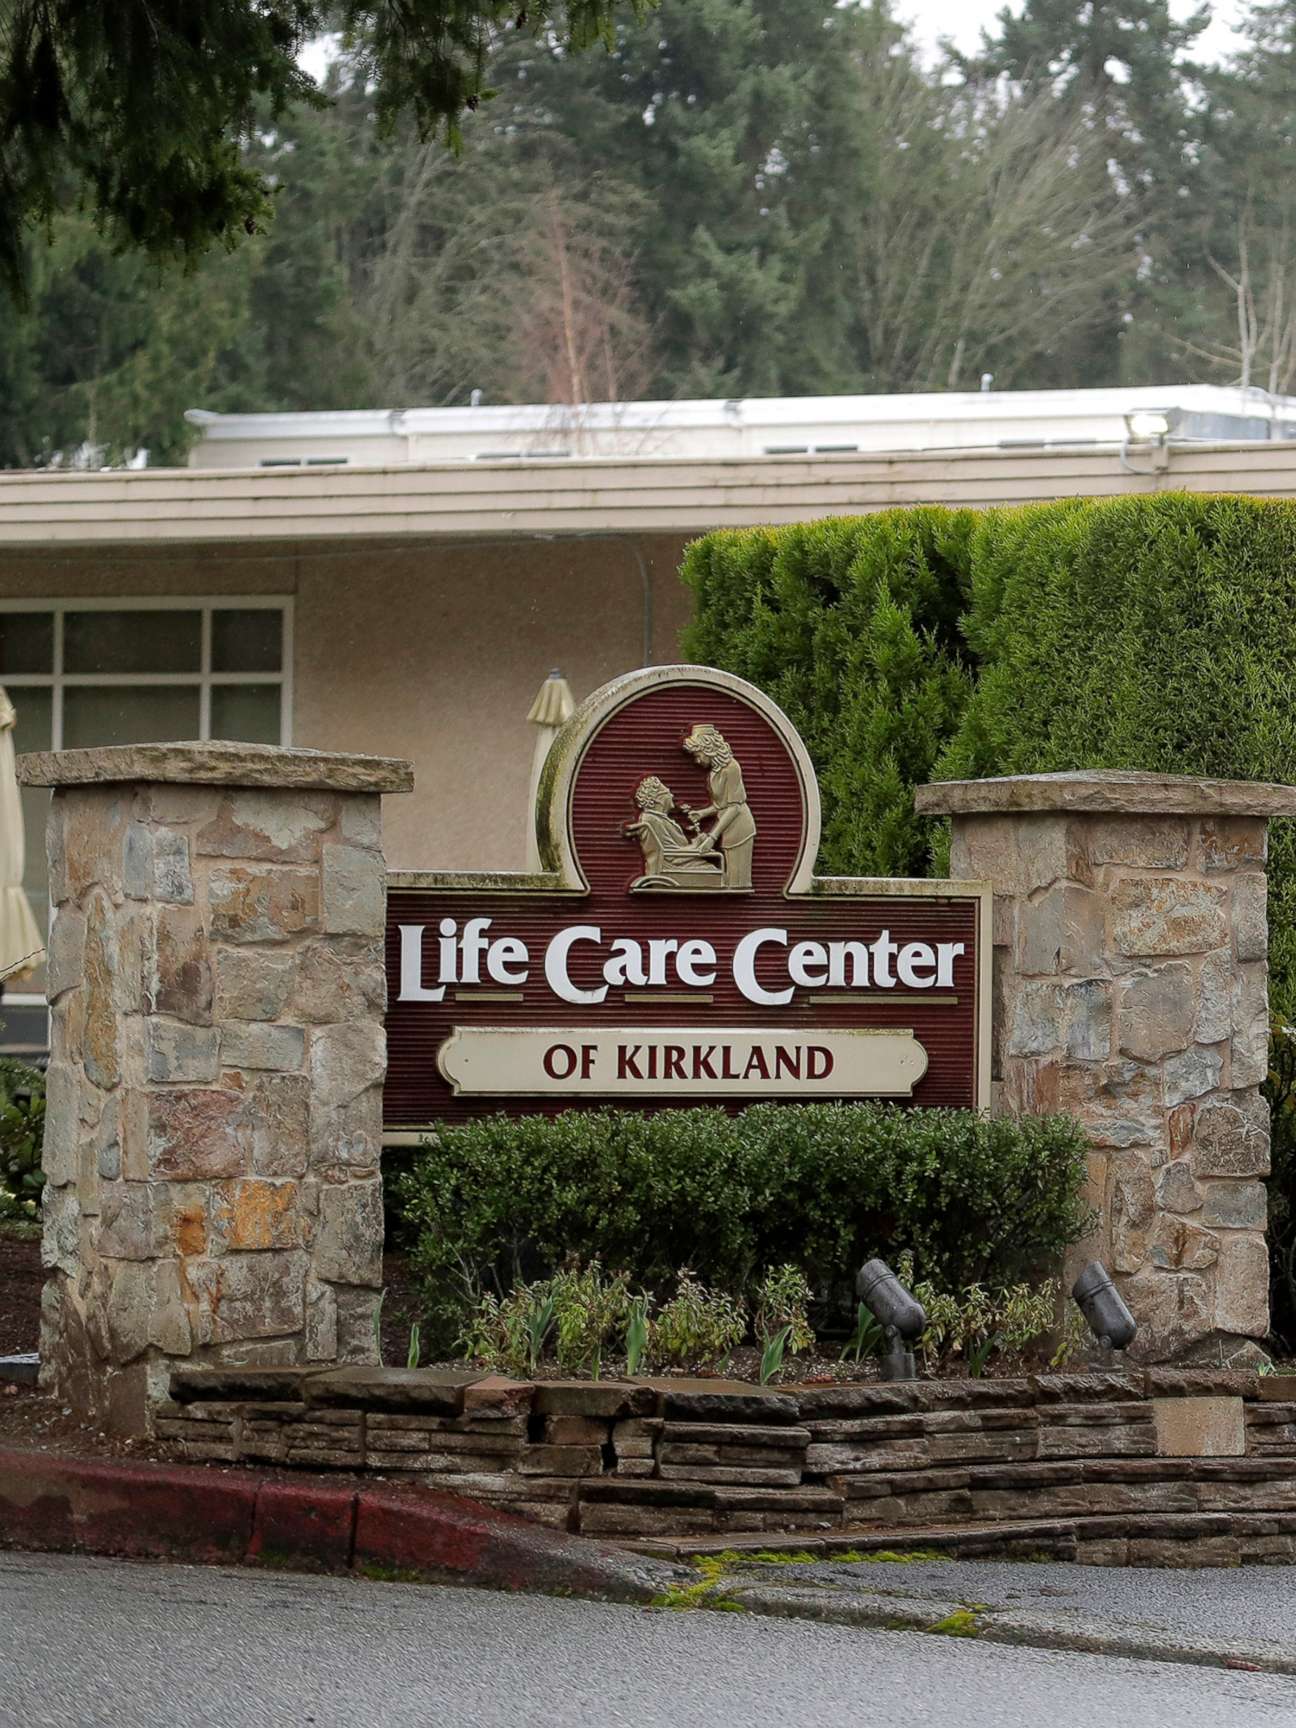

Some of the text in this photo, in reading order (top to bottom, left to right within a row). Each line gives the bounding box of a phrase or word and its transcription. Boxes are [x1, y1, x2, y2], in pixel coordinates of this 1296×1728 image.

[397, 917, 964, 1005] Life Care Center
[543, 1045, 834, 1080] OF KIRKLAND
